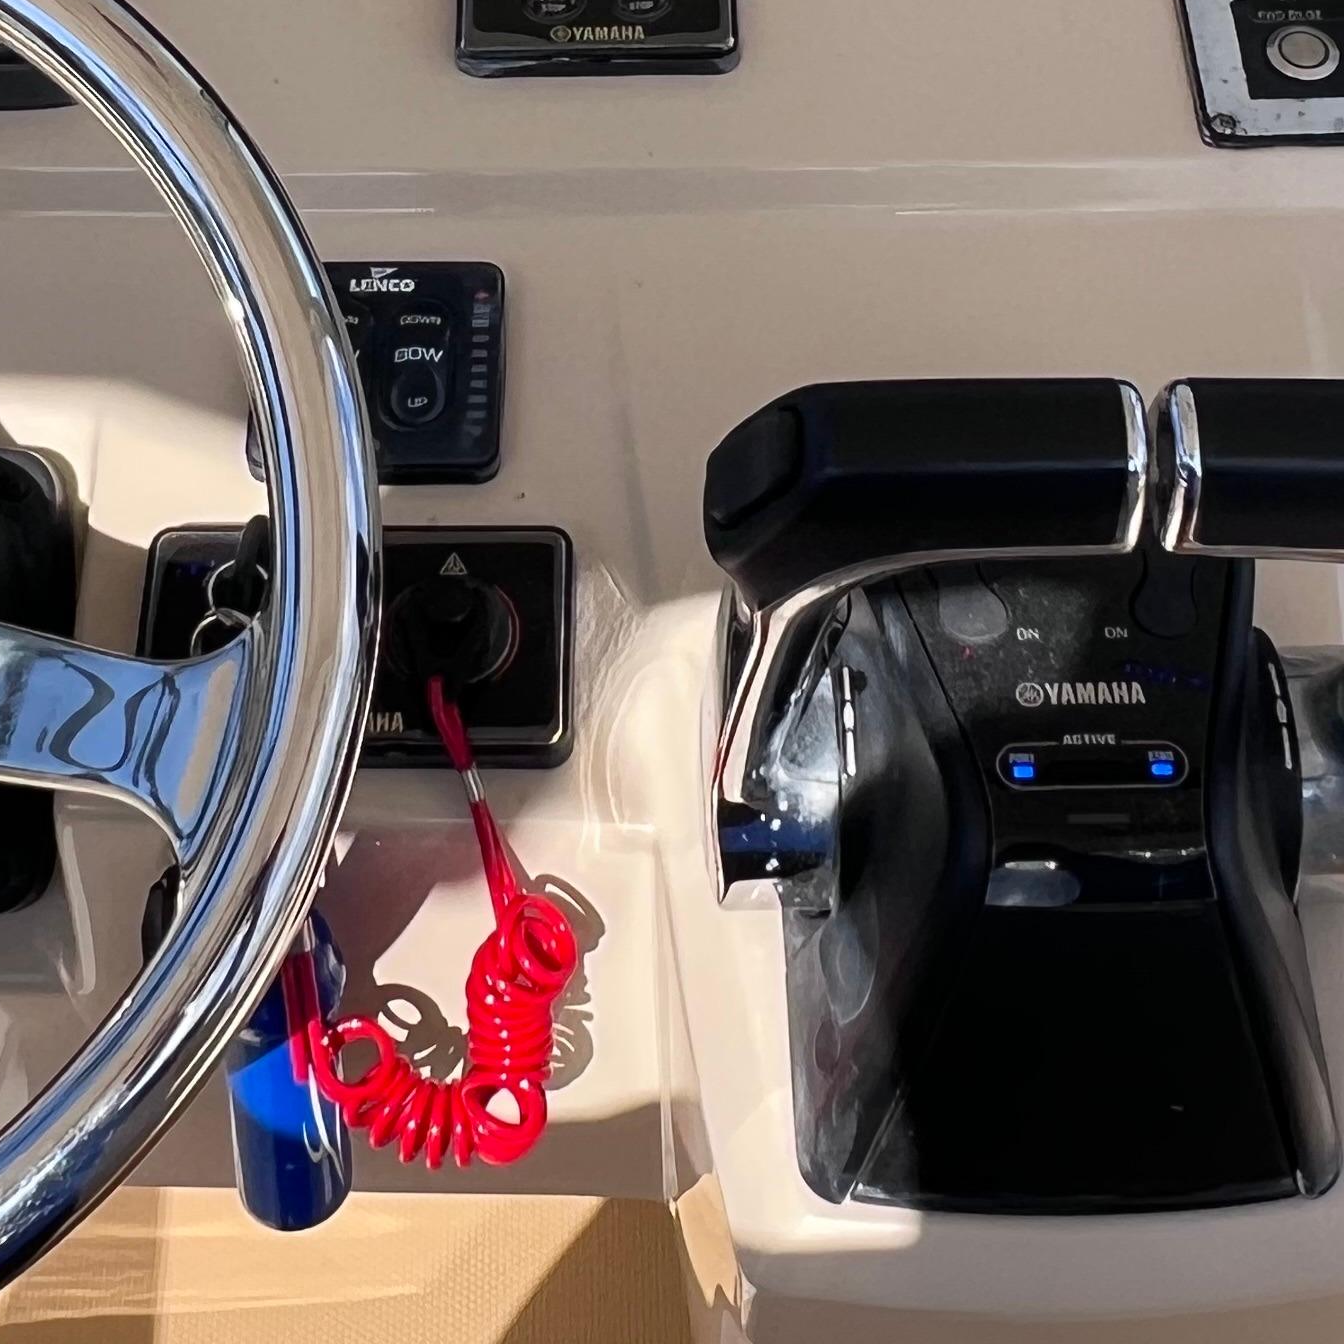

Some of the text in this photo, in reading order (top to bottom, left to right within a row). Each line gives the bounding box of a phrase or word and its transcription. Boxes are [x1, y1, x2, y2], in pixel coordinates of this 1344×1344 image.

[572, 25, 646, 42] YAMAHA
[349, 277, 416, 293] LENCO
[394, 346, 444, 363] BOW
[407, 395, 429, 408] UP
[1016, 627, 1041, 641] ON
[1104, 626, 1129, 639] ON
[1044, 681, 1147, 706] YAMAHA
[1062, 734, 1117, 746] ACTIVE
